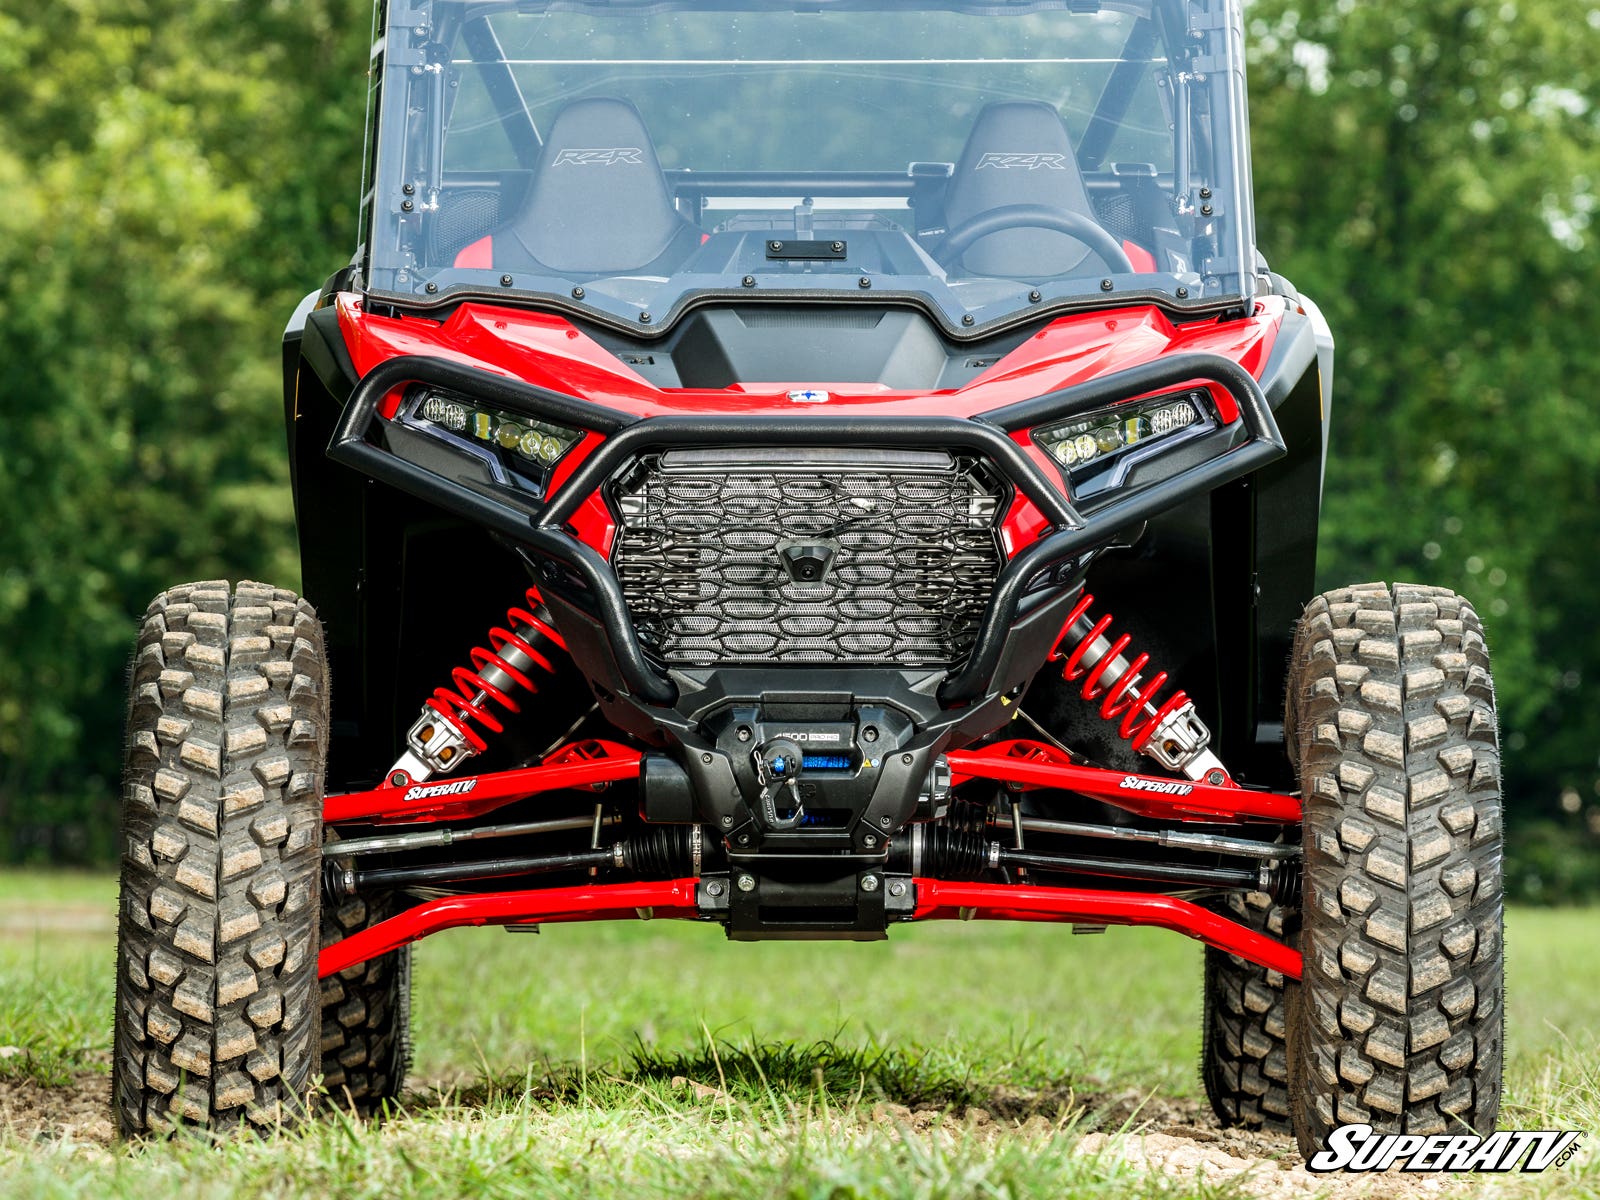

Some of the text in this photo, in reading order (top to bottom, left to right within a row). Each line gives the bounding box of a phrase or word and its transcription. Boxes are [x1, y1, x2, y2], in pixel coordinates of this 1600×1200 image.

[552, 147, 643, 166] RZR
[975, 152, 1066, 170] RZR
[403, 779, 477, 801] SUPERATV
[1120, 776, 1193, 796] SUPERATV
